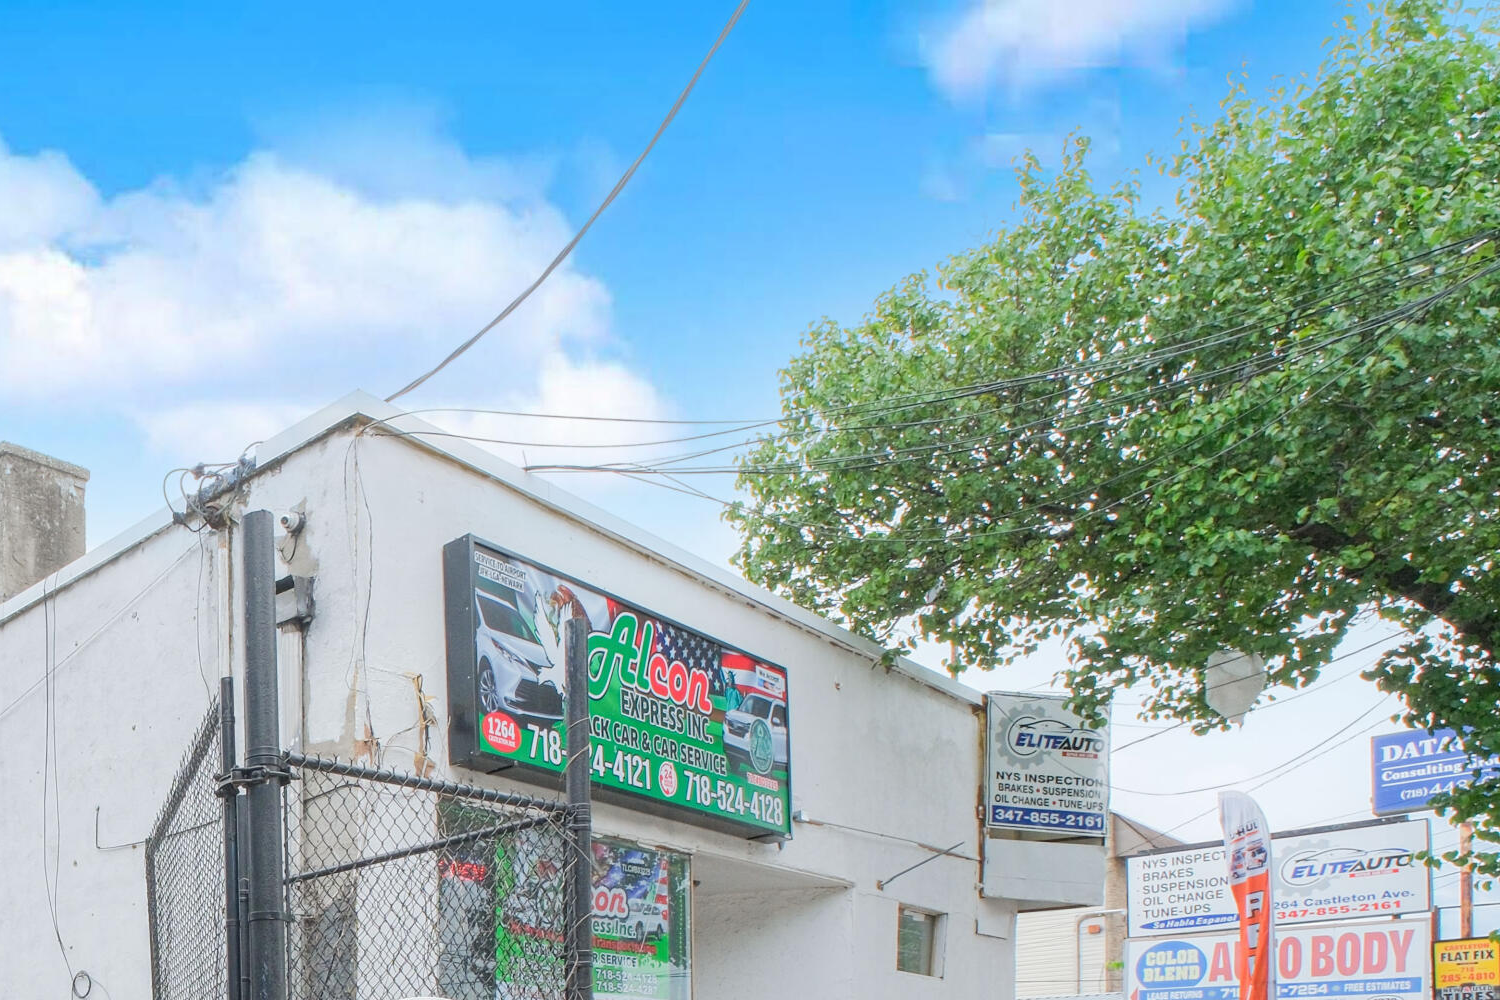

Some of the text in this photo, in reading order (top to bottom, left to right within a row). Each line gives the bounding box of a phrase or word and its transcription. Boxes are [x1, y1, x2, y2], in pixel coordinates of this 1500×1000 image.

[588, 612, 713, 715] Alcon
[620, 687, 714, 744] EXPRESS INC.
[488, 717, 516, 740] 1264
[613, 721, 640, 750] CAR
[641, 730, 651, 753] &
[653, 735, 679, 762] CAR
[680, 743, 727, 776] SERVICE
[996, 771, 1104, 788] NYS INSPECTION
[1382, 762, 1464, 781] Consulting
[684, 770, 783, 825] 718-524-4128
[998, 783, 1101, 799] BRAKES SUSPENSION
[1400, 787, 1428, 800] (718)
[994, 794, 1104, 811] OIL CHANGE TUNE-UPS
[995, 809, 1103, 828] 347-855-2161
[1142, 851, 1226, 870] NYS INSPECT
[1142, 868, 1194, 882] BRAKES
[1142, 876, 1229, 895] SUSPENSION
[1143, 890, 1224, 907] OIL CHANGE
[1274, 889, 1415, 910] 264 Castleton Ave.
[1144, 904, 1212, 919] TUNE-UPS
[1276, 900, 1401, 920] 347-855-2161
[600, 954, 637, 968] SERVICE
[1146, 948, 1199, 966] COLOR
[1311, 930, 1415, 977] BODY
[1440, 950, 1494, 962] FLAT FIX
[1144, 965, 1200, 982] BLEND
[1441, 972, 1496, 982] 285-4810
[1146, 992, 1168, 1000] LEASE
[1170, 990, 1203, 1000] RETURNS
[1344, 982, 1364, 992] FREE
[1366, 981, 1412, 992] ESTIMATES
